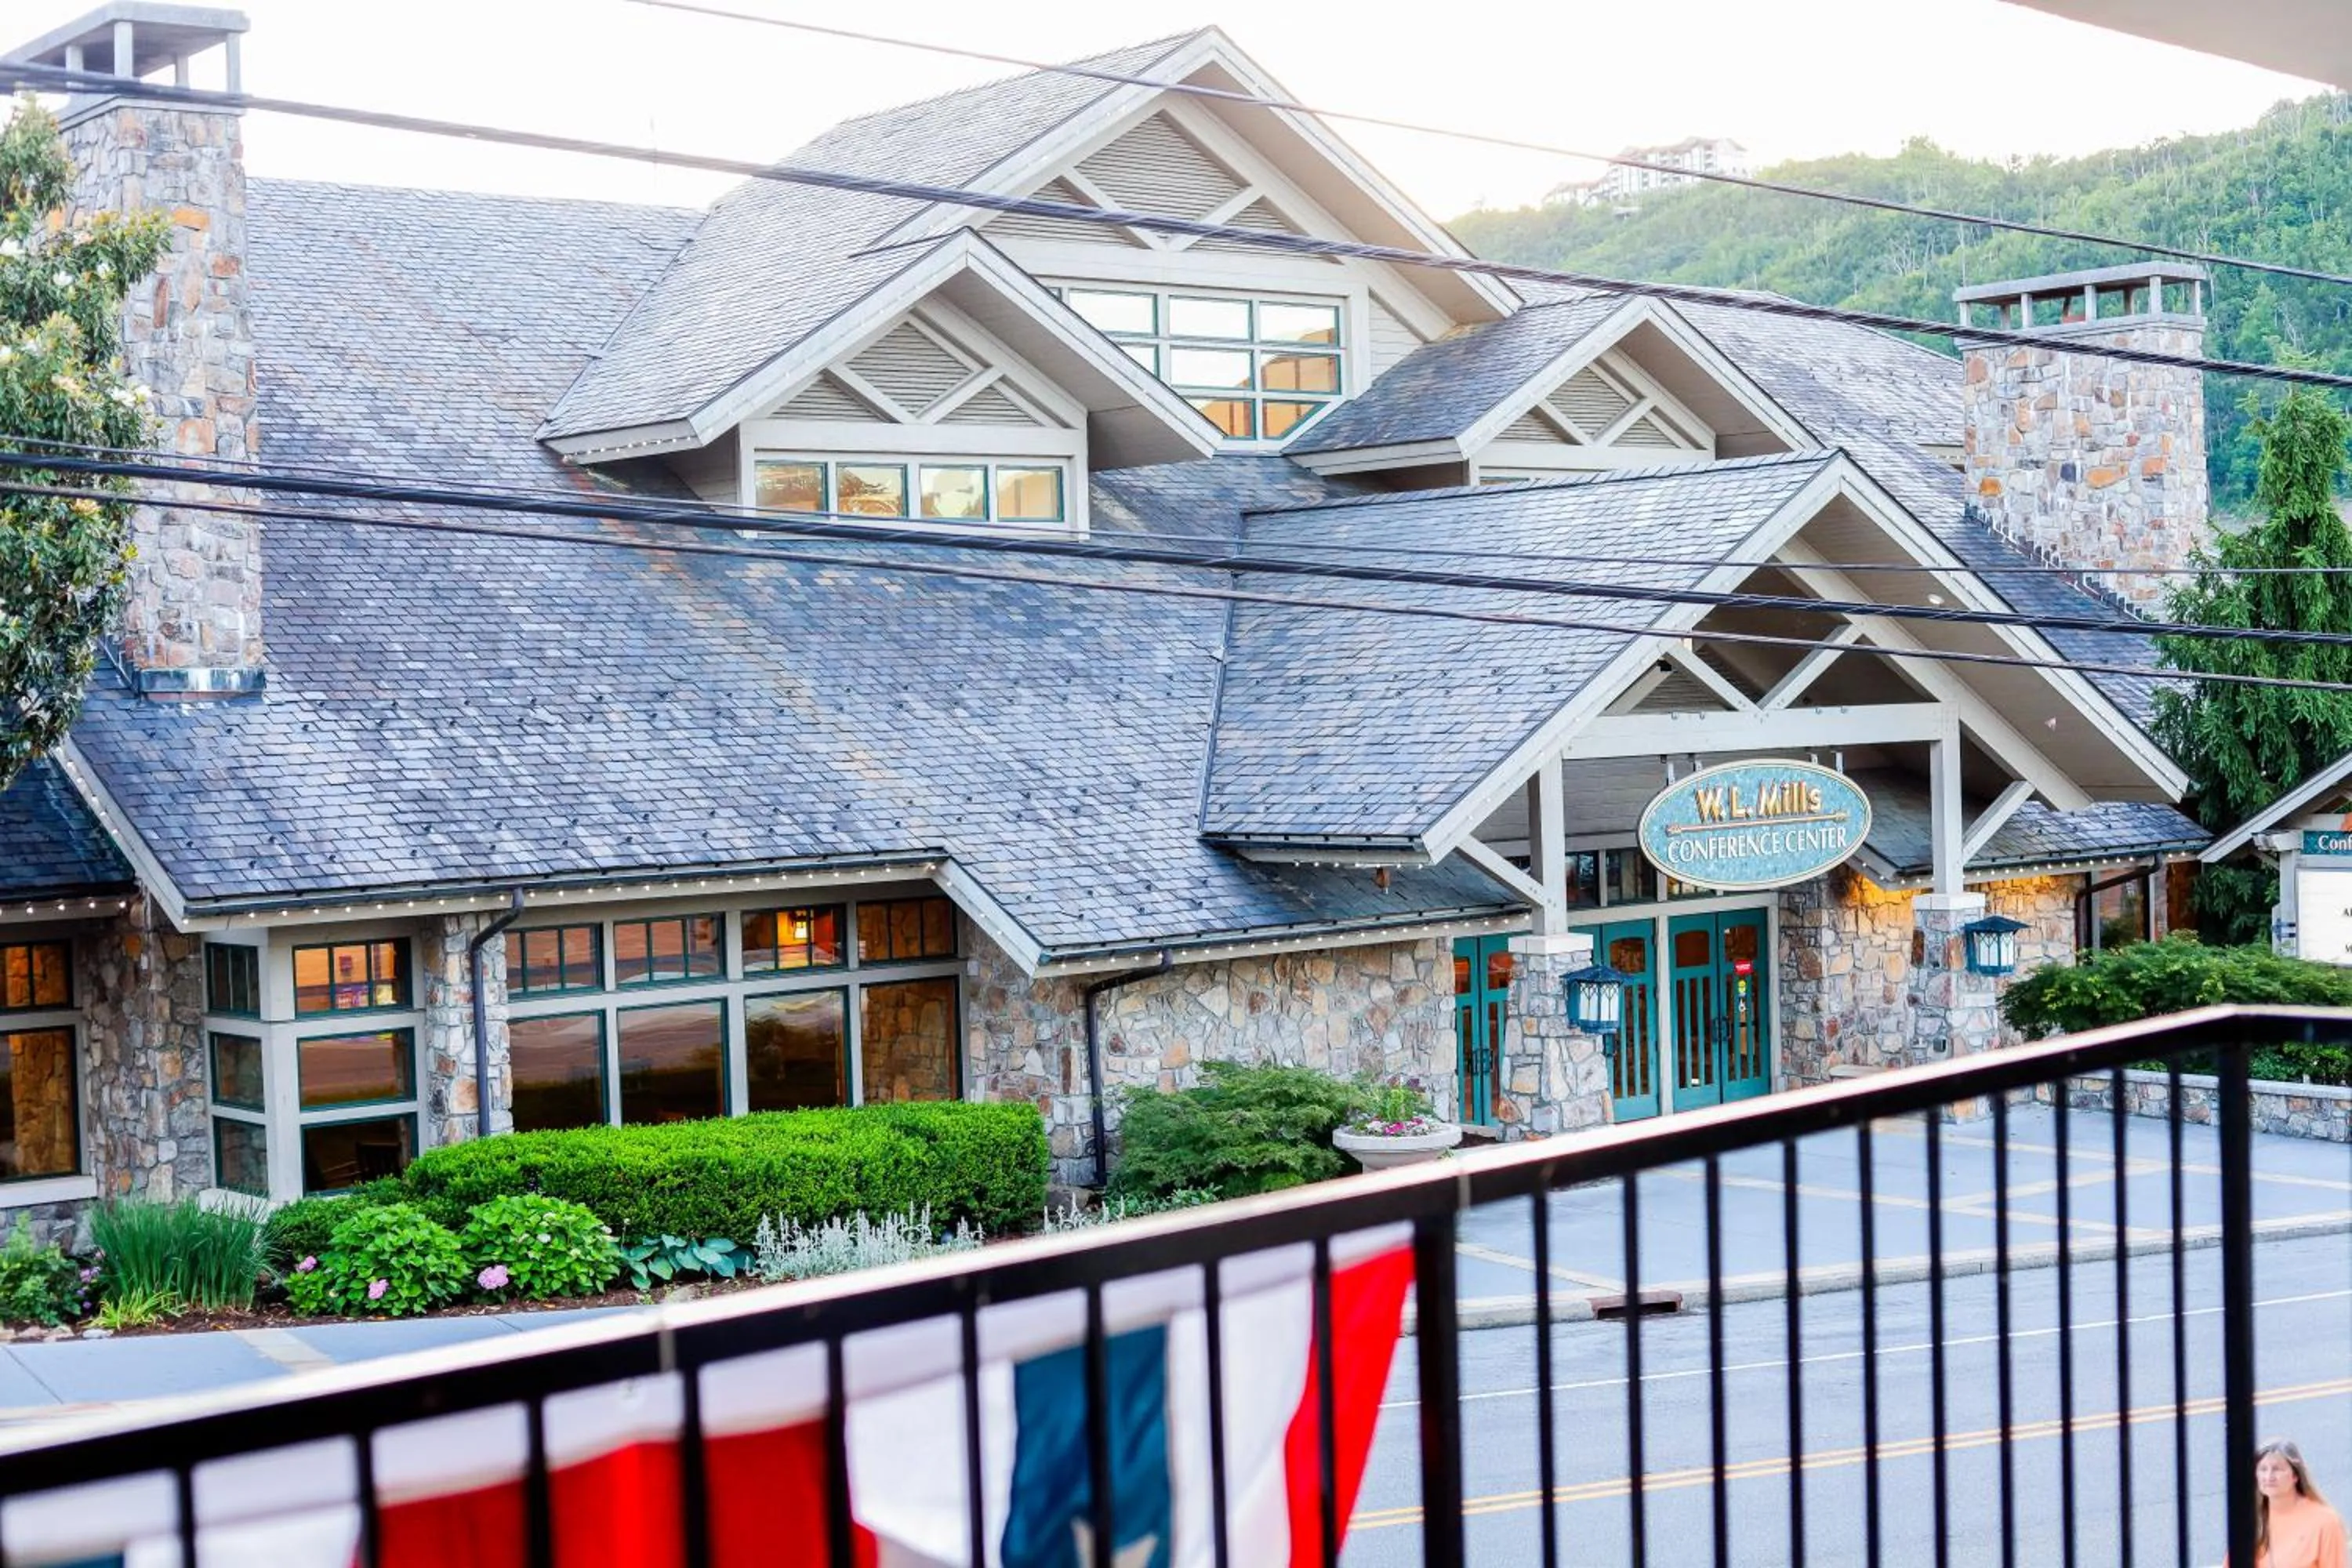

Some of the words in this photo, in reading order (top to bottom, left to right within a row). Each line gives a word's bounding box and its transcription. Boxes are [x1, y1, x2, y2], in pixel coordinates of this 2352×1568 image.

[1756, 779, 1822, 816] Mills
[1667, 831, 1780, 863] CONFERENCE
[1785, 827, 1847, 852] CENTER
